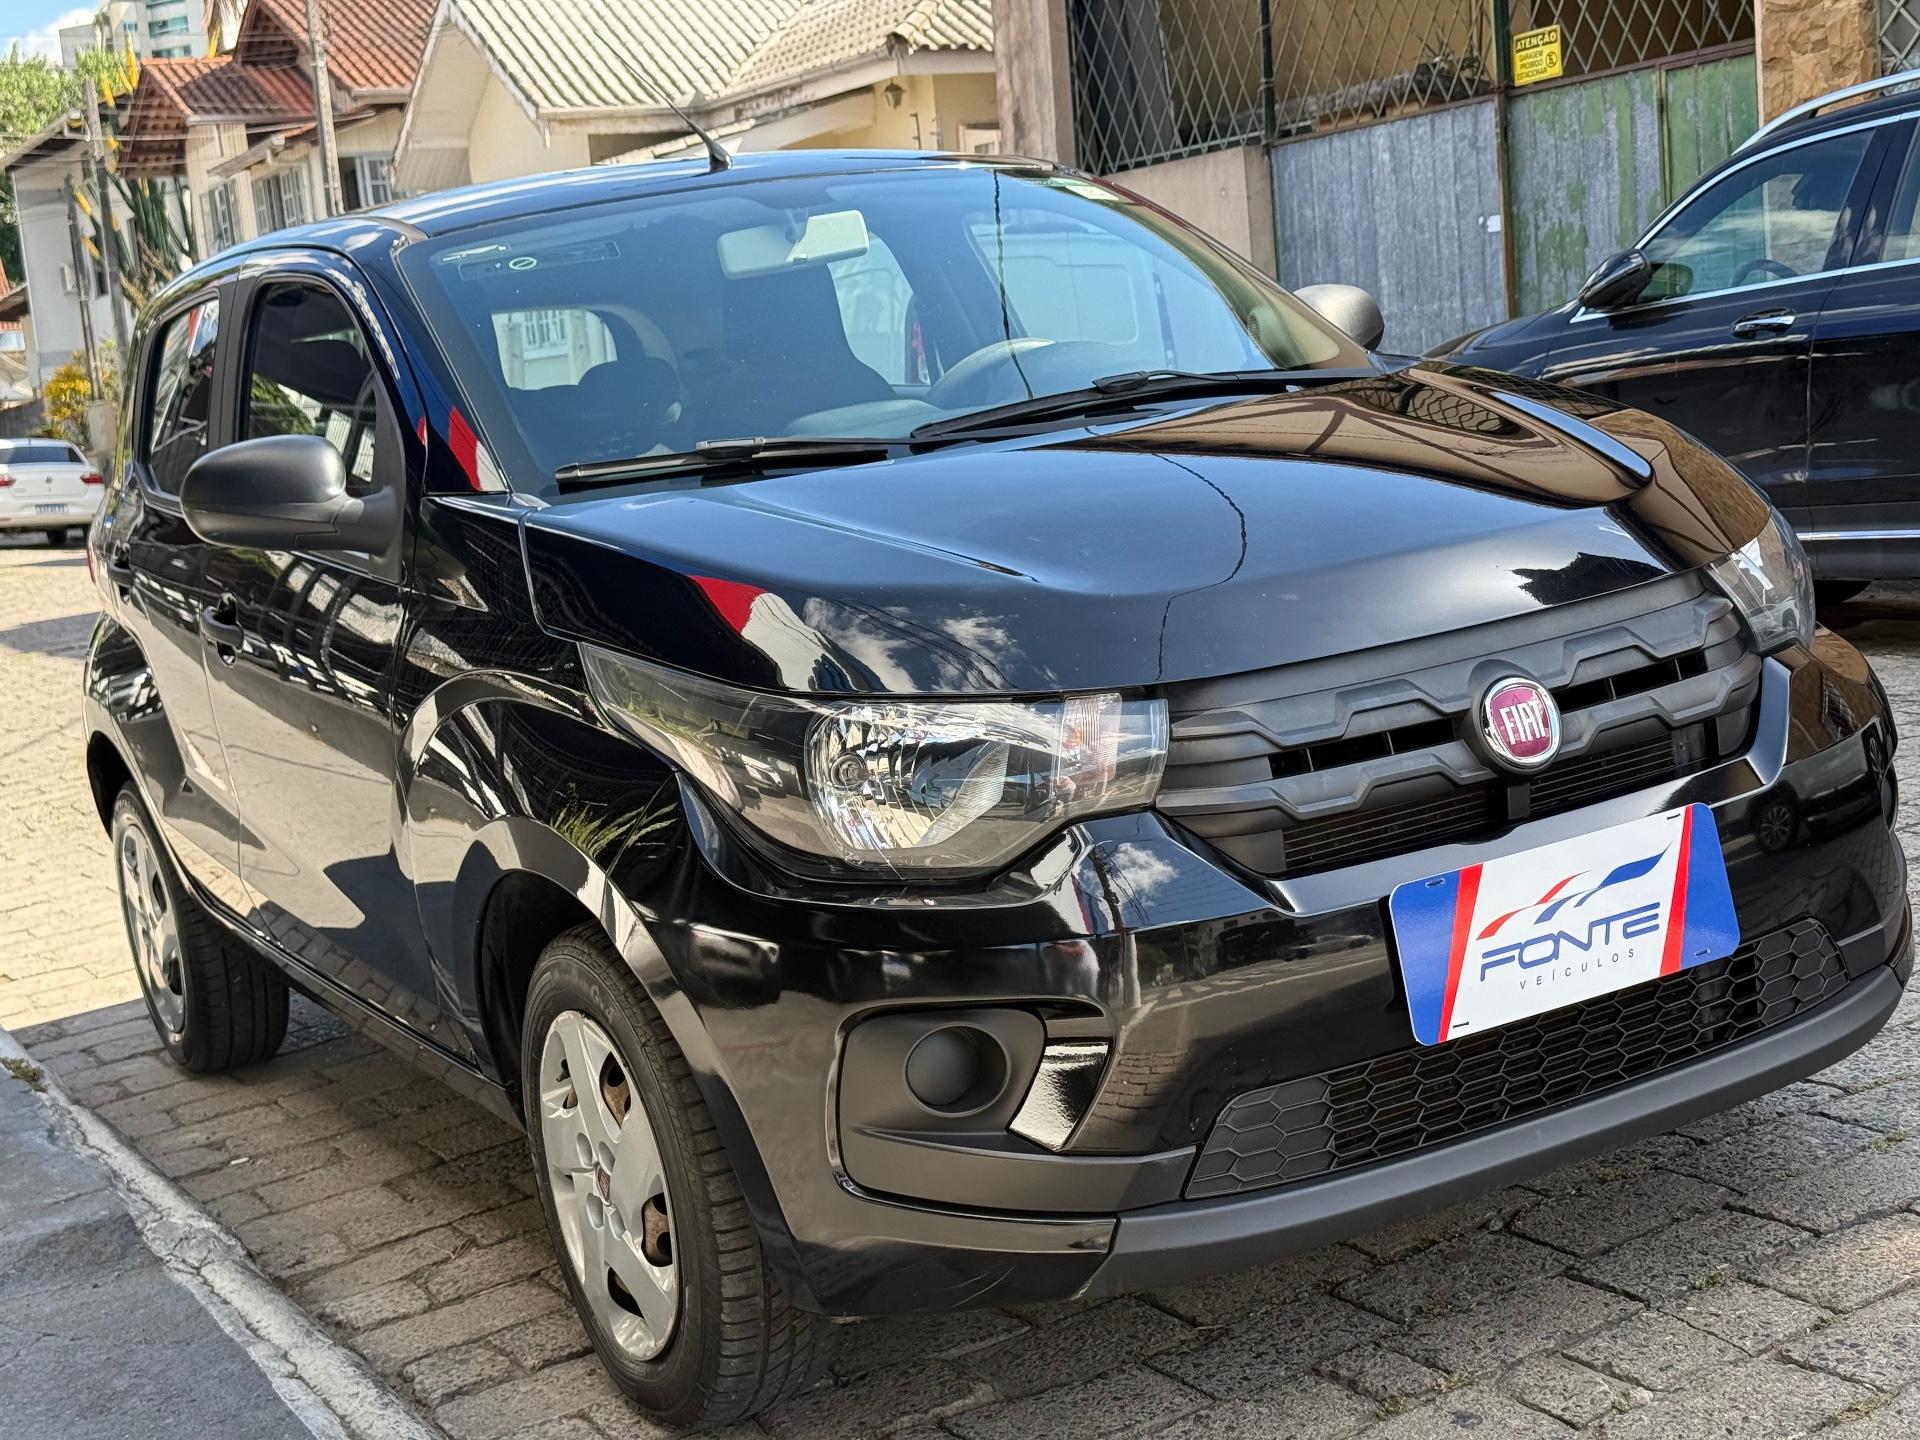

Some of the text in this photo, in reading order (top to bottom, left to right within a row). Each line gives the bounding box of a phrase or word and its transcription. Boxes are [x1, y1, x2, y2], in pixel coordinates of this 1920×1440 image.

[1516, 30, 1557, 50] ATENÇÃO
[1519, 58, 1544, 70] PROIBIDO
[1499, 700, 1546, 745] FIAT
[1480, 901, 1661, 982] FONTE
[1519, 947, 1635, 990] VEÍCULOS
